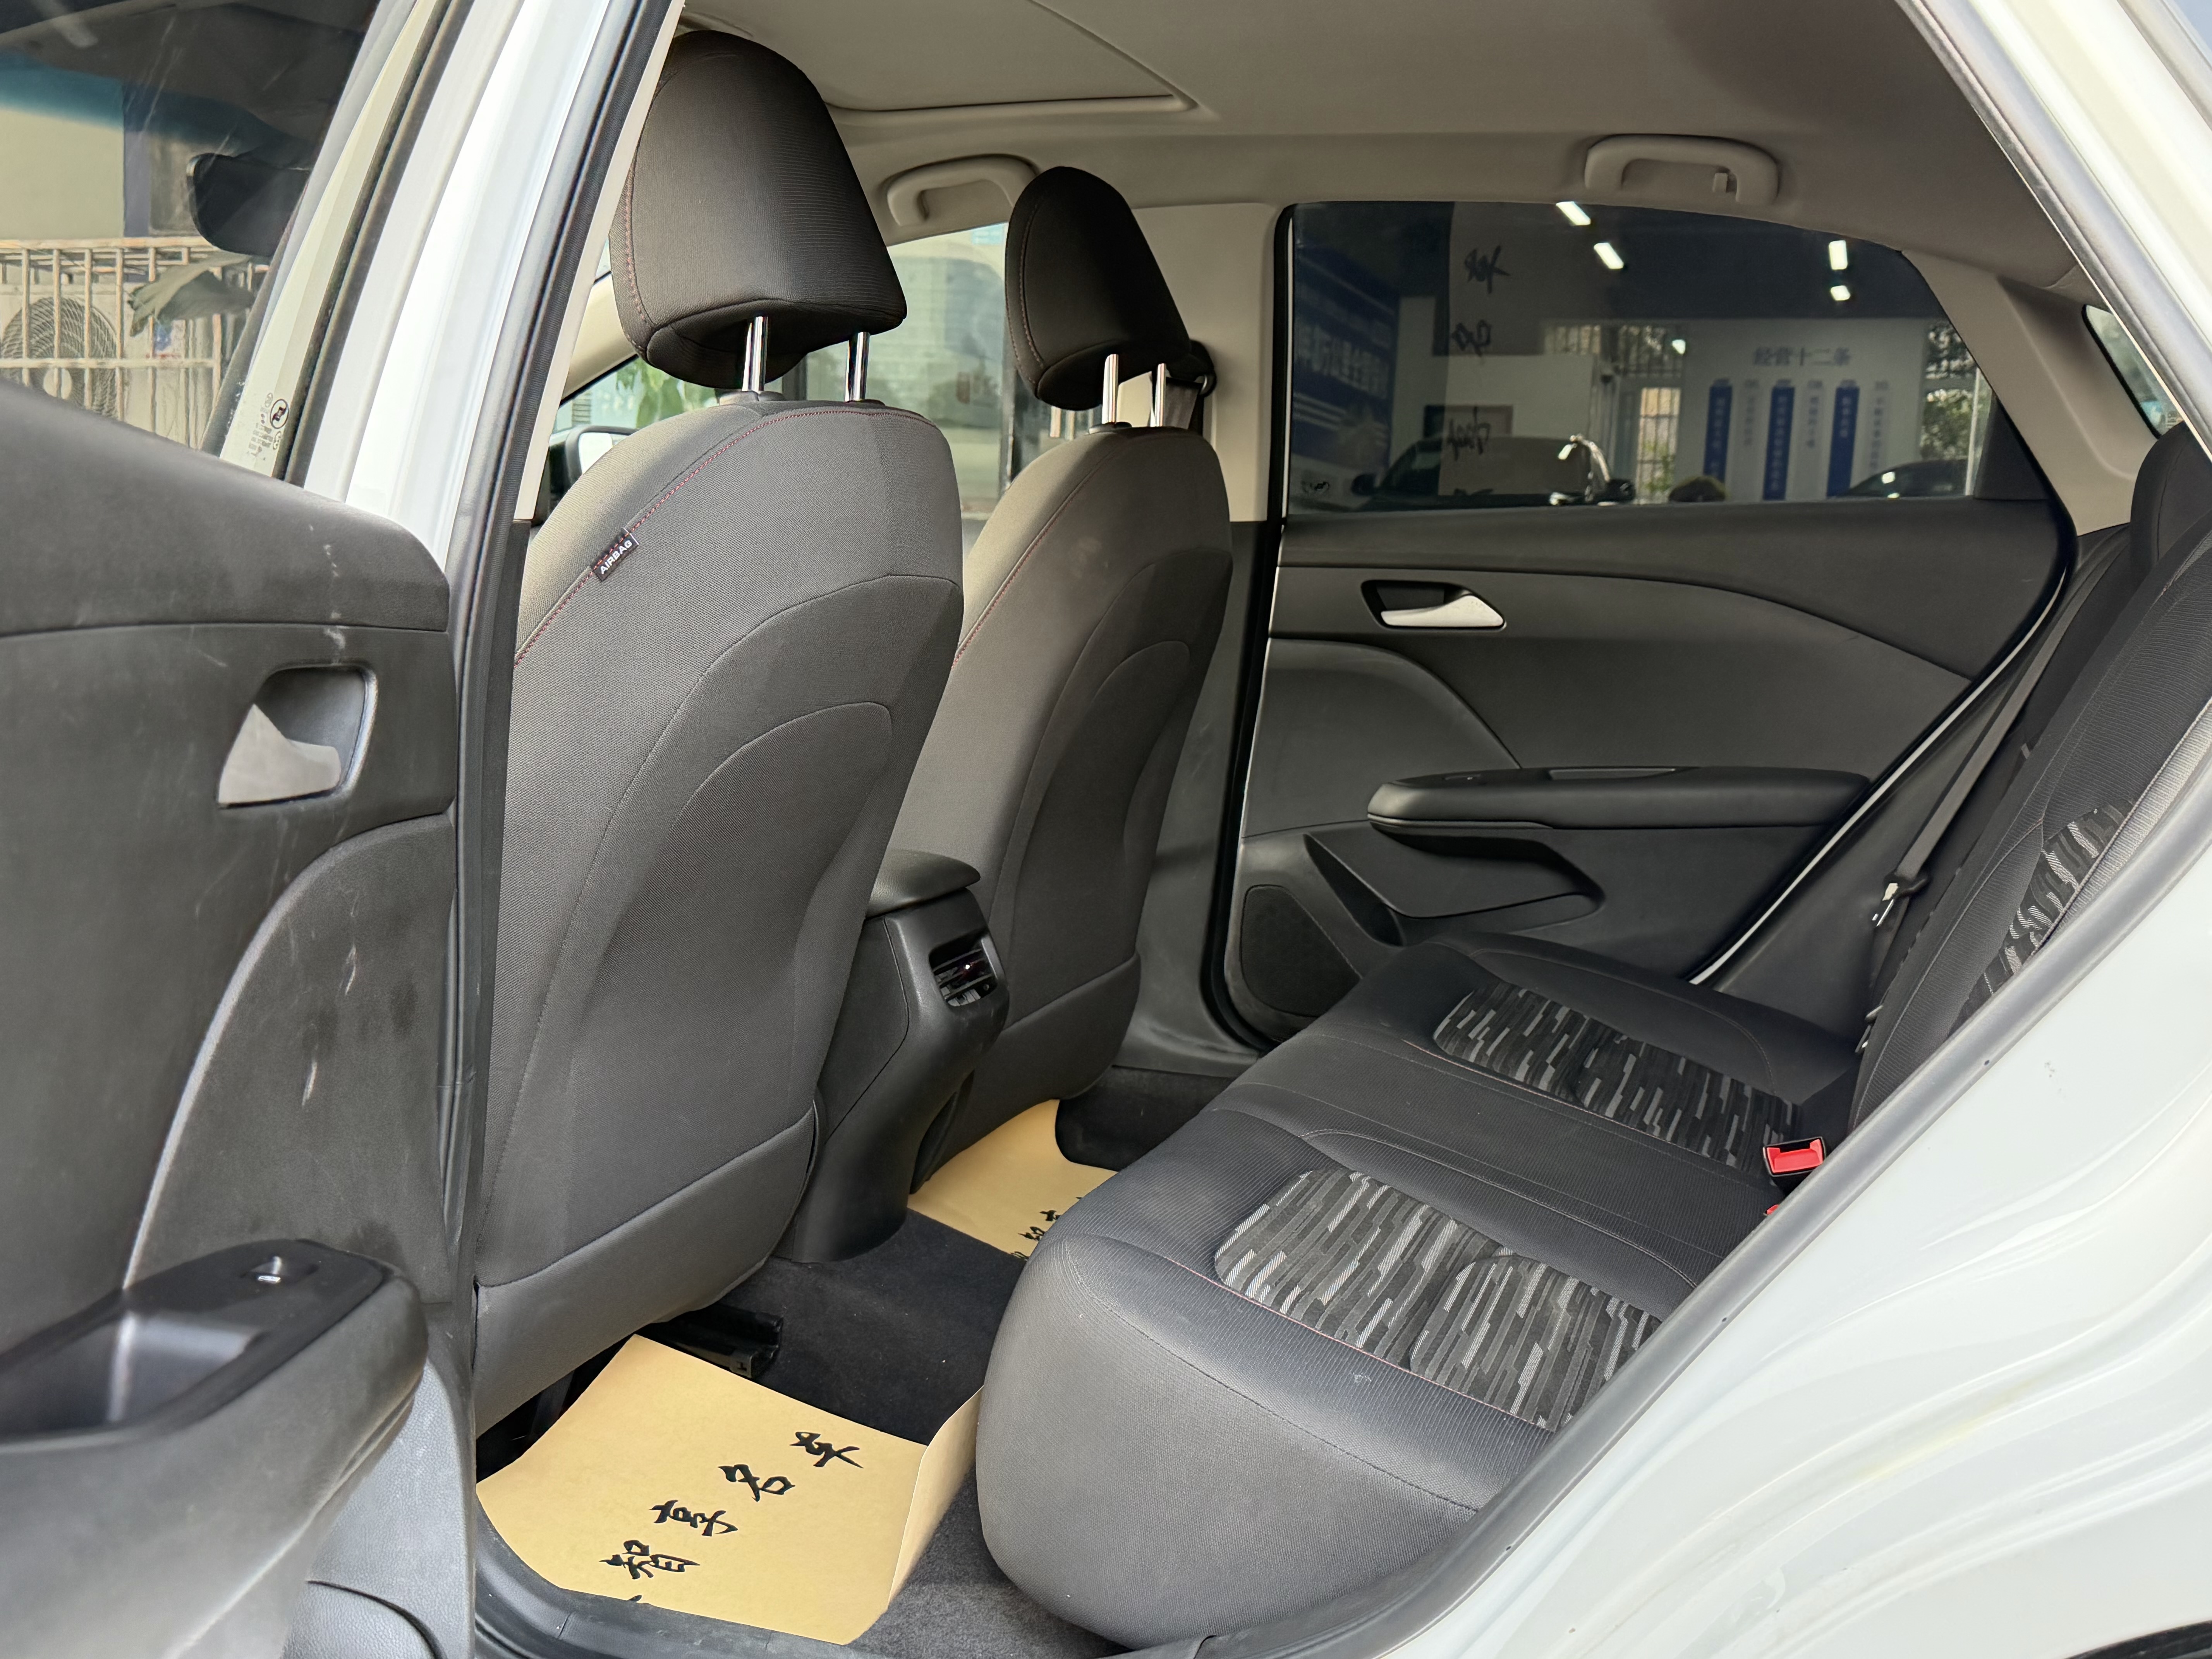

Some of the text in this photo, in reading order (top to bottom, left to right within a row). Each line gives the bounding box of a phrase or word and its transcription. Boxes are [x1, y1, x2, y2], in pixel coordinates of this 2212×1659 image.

[600, 539, 632, 575] AIRBAG
[599, 1431, 864, 1604] 智享名车
